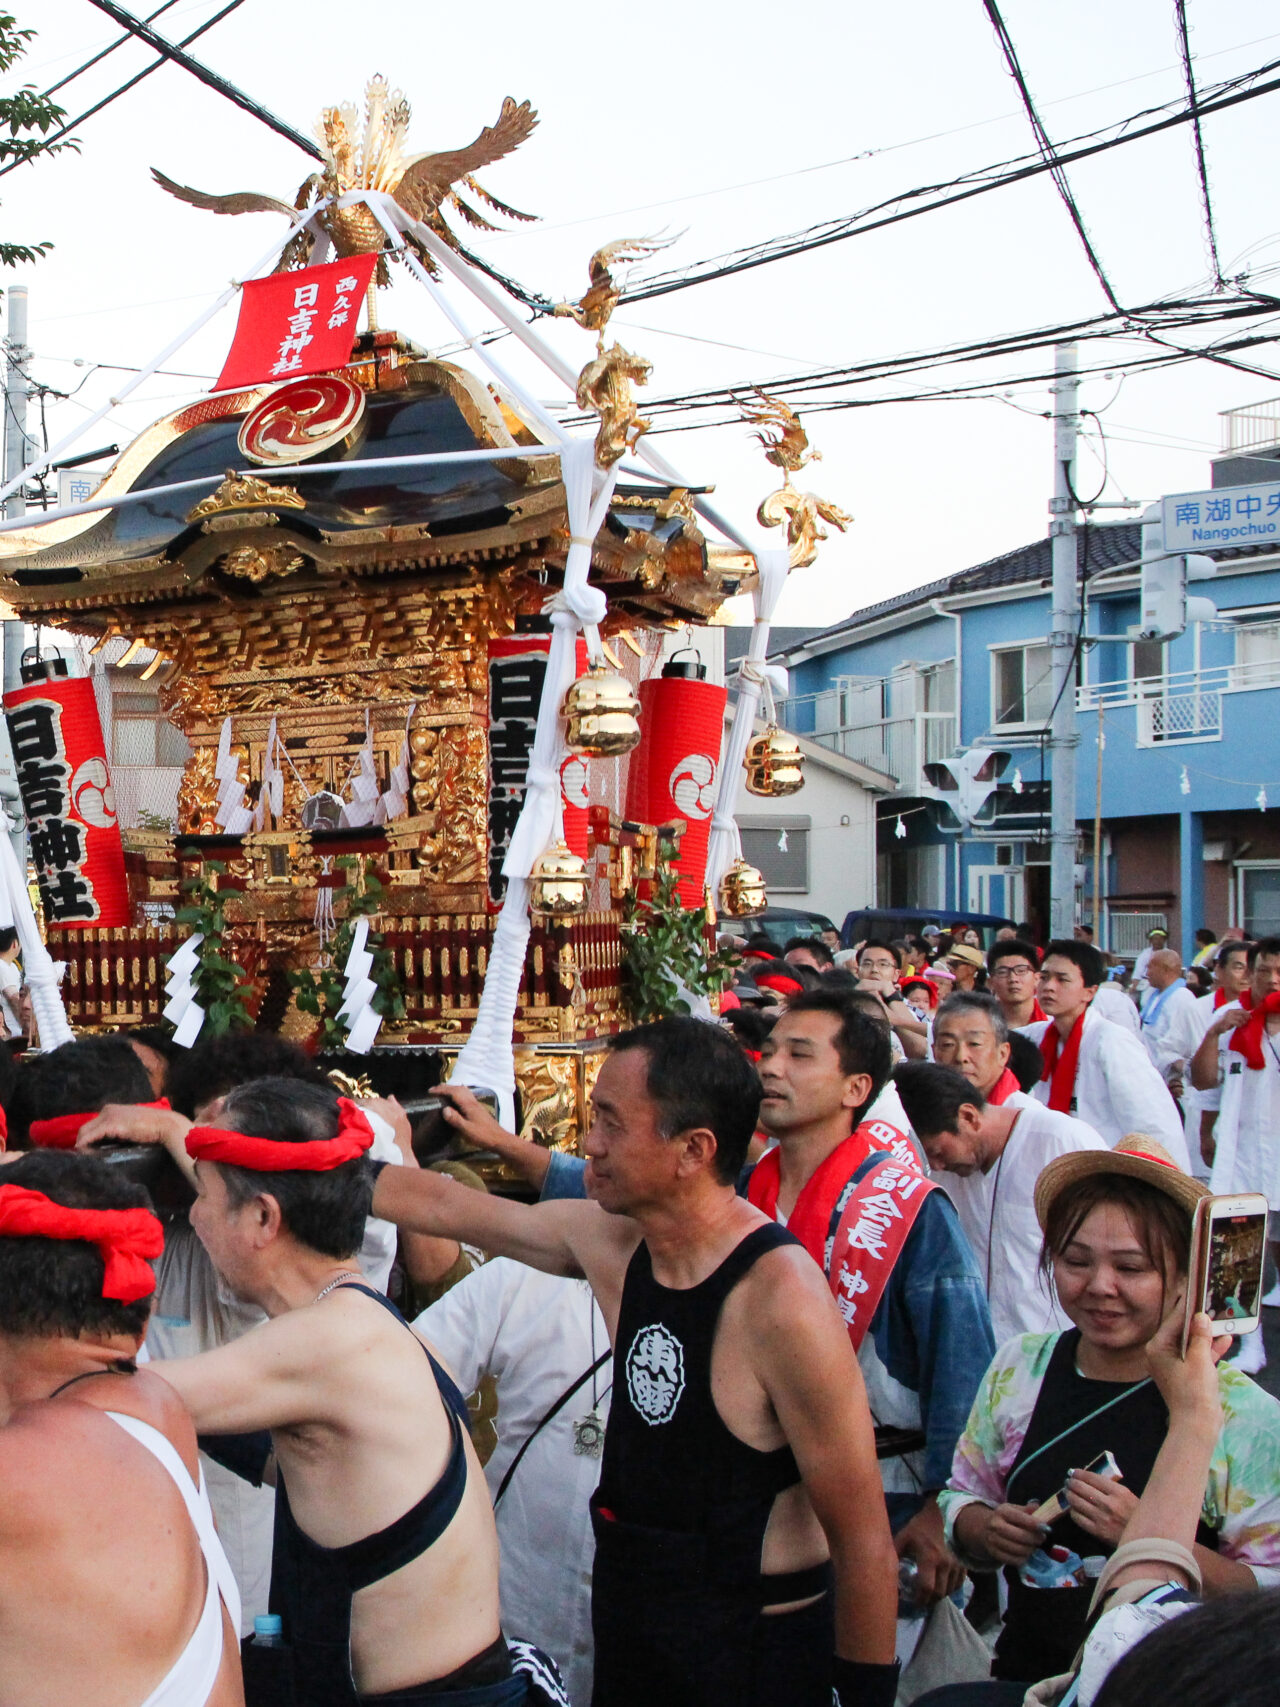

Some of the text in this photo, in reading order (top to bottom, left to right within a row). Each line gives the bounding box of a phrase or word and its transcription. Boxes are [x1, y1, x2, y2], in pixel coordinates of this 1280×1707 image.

[267, 282, 320, 376] 日吉神社
[327, 275, 358, 330] 西久保
[70, 480, 100, 503] 南
[1192, 522, 1277, 541] Nangochuo
[5, 704, 97, 923] 日吉神社
